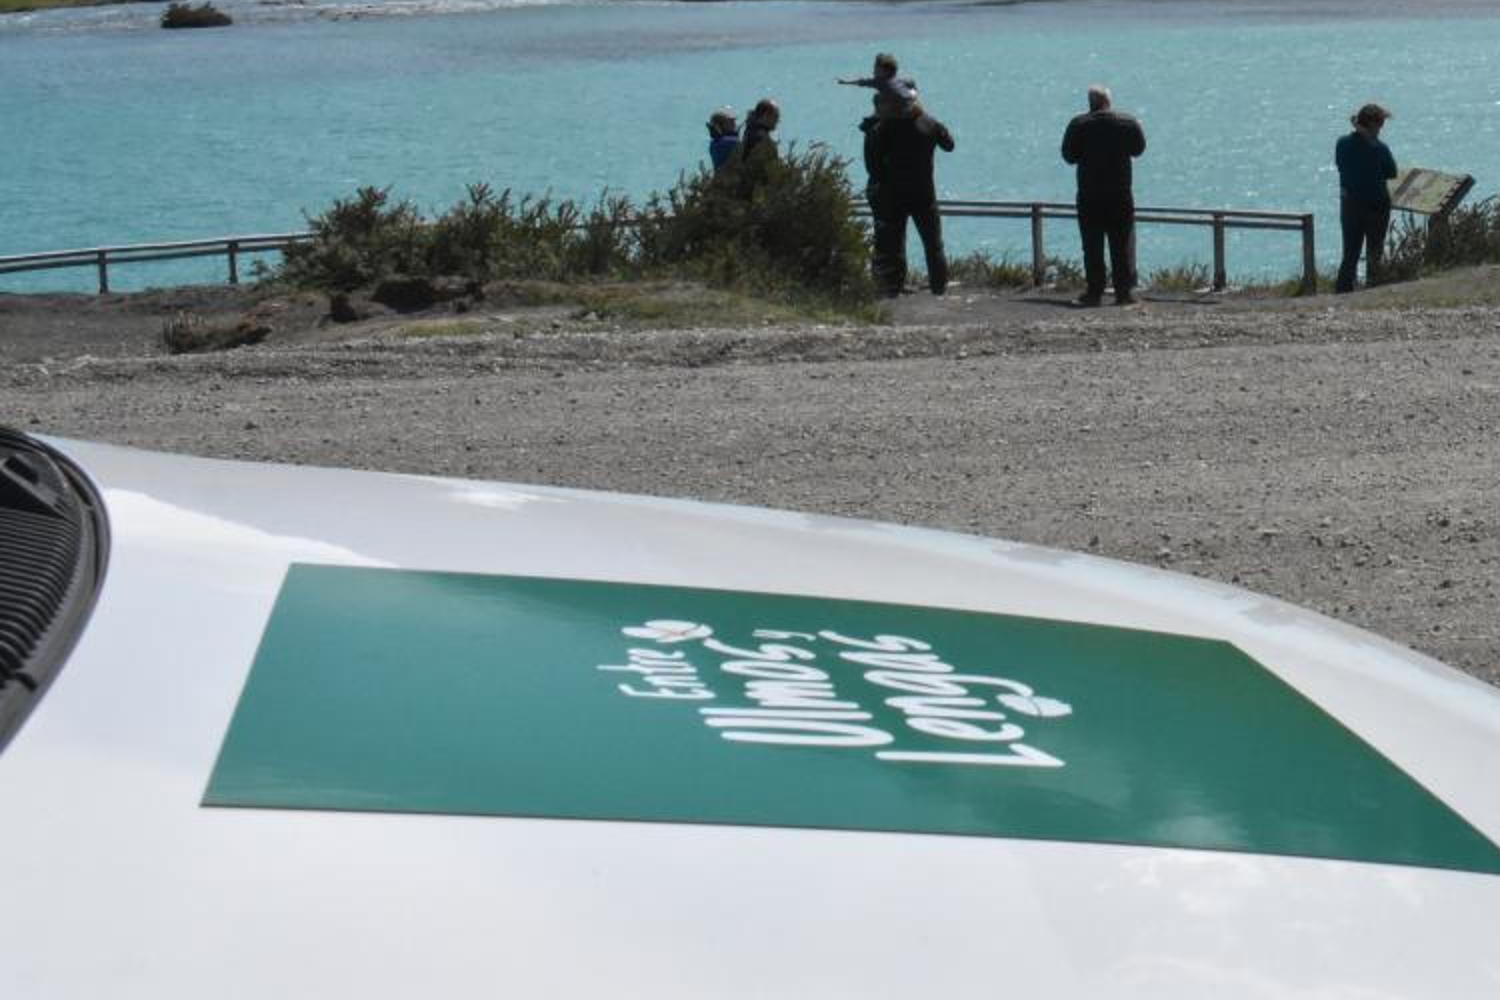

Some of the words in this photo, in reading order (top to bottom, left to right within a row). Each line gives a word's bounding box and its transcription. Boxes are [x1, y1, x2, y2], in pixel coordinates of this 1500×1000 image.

[596, 647, 716, 700] Entre
[752, 629, 816, 640] y
[698, 637, 895, 746] Ulmos
[818, 630, 1067, 767] Lengas
